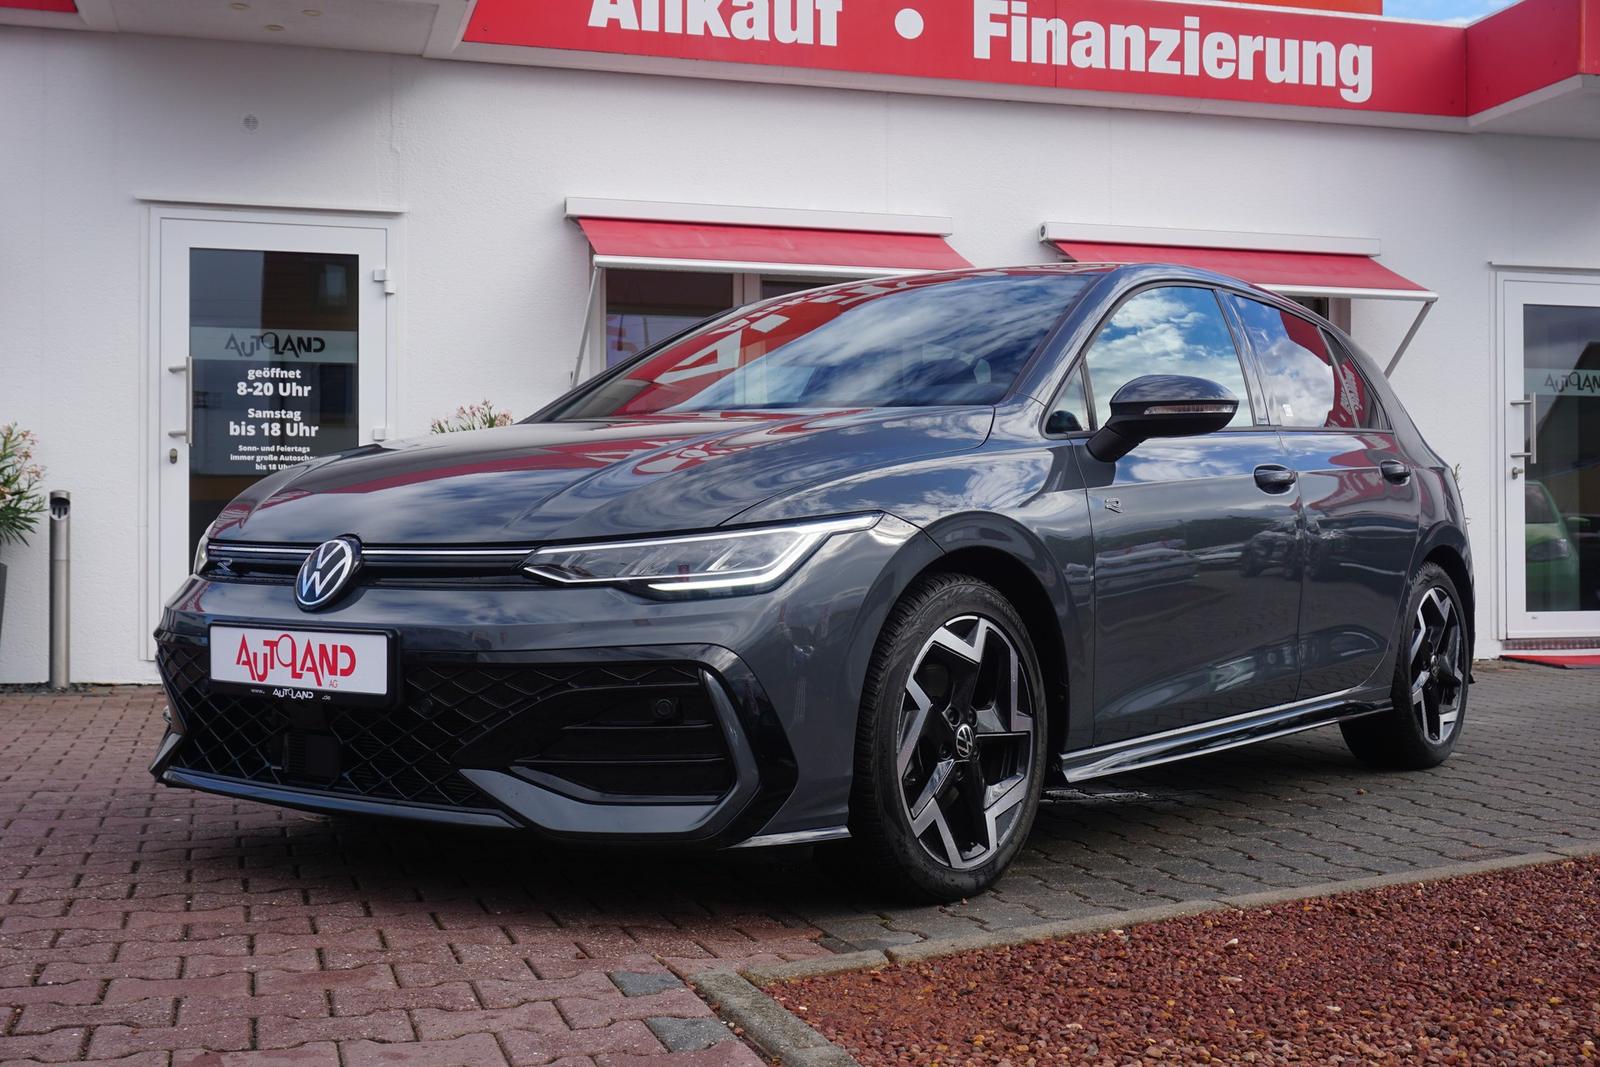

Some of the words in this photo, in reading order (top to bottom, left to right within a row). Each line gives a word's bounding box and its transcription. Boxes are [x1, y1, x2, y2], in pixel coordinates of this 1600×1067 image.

[973, 0, 1372, 103] Finanzierung
[247, 367, 302, 381] geöffnet
[236, 381, 274, 396] 8-20
[278, 382, 312, 397] Uhr
[247, 408, 302, 422] Samstag
[229, 421, 256, 436] bis
[261, 422, 281, 437] 18
[285, 422, 319, 437] Uhr
[238, 444, 260, 452] Sonn-
[276, 445, 311, 454] Feiertags
[255, 454, 278, 462] große
[279, 454, 317, 462] Autosch
[328, 679, 338, 689] AG
